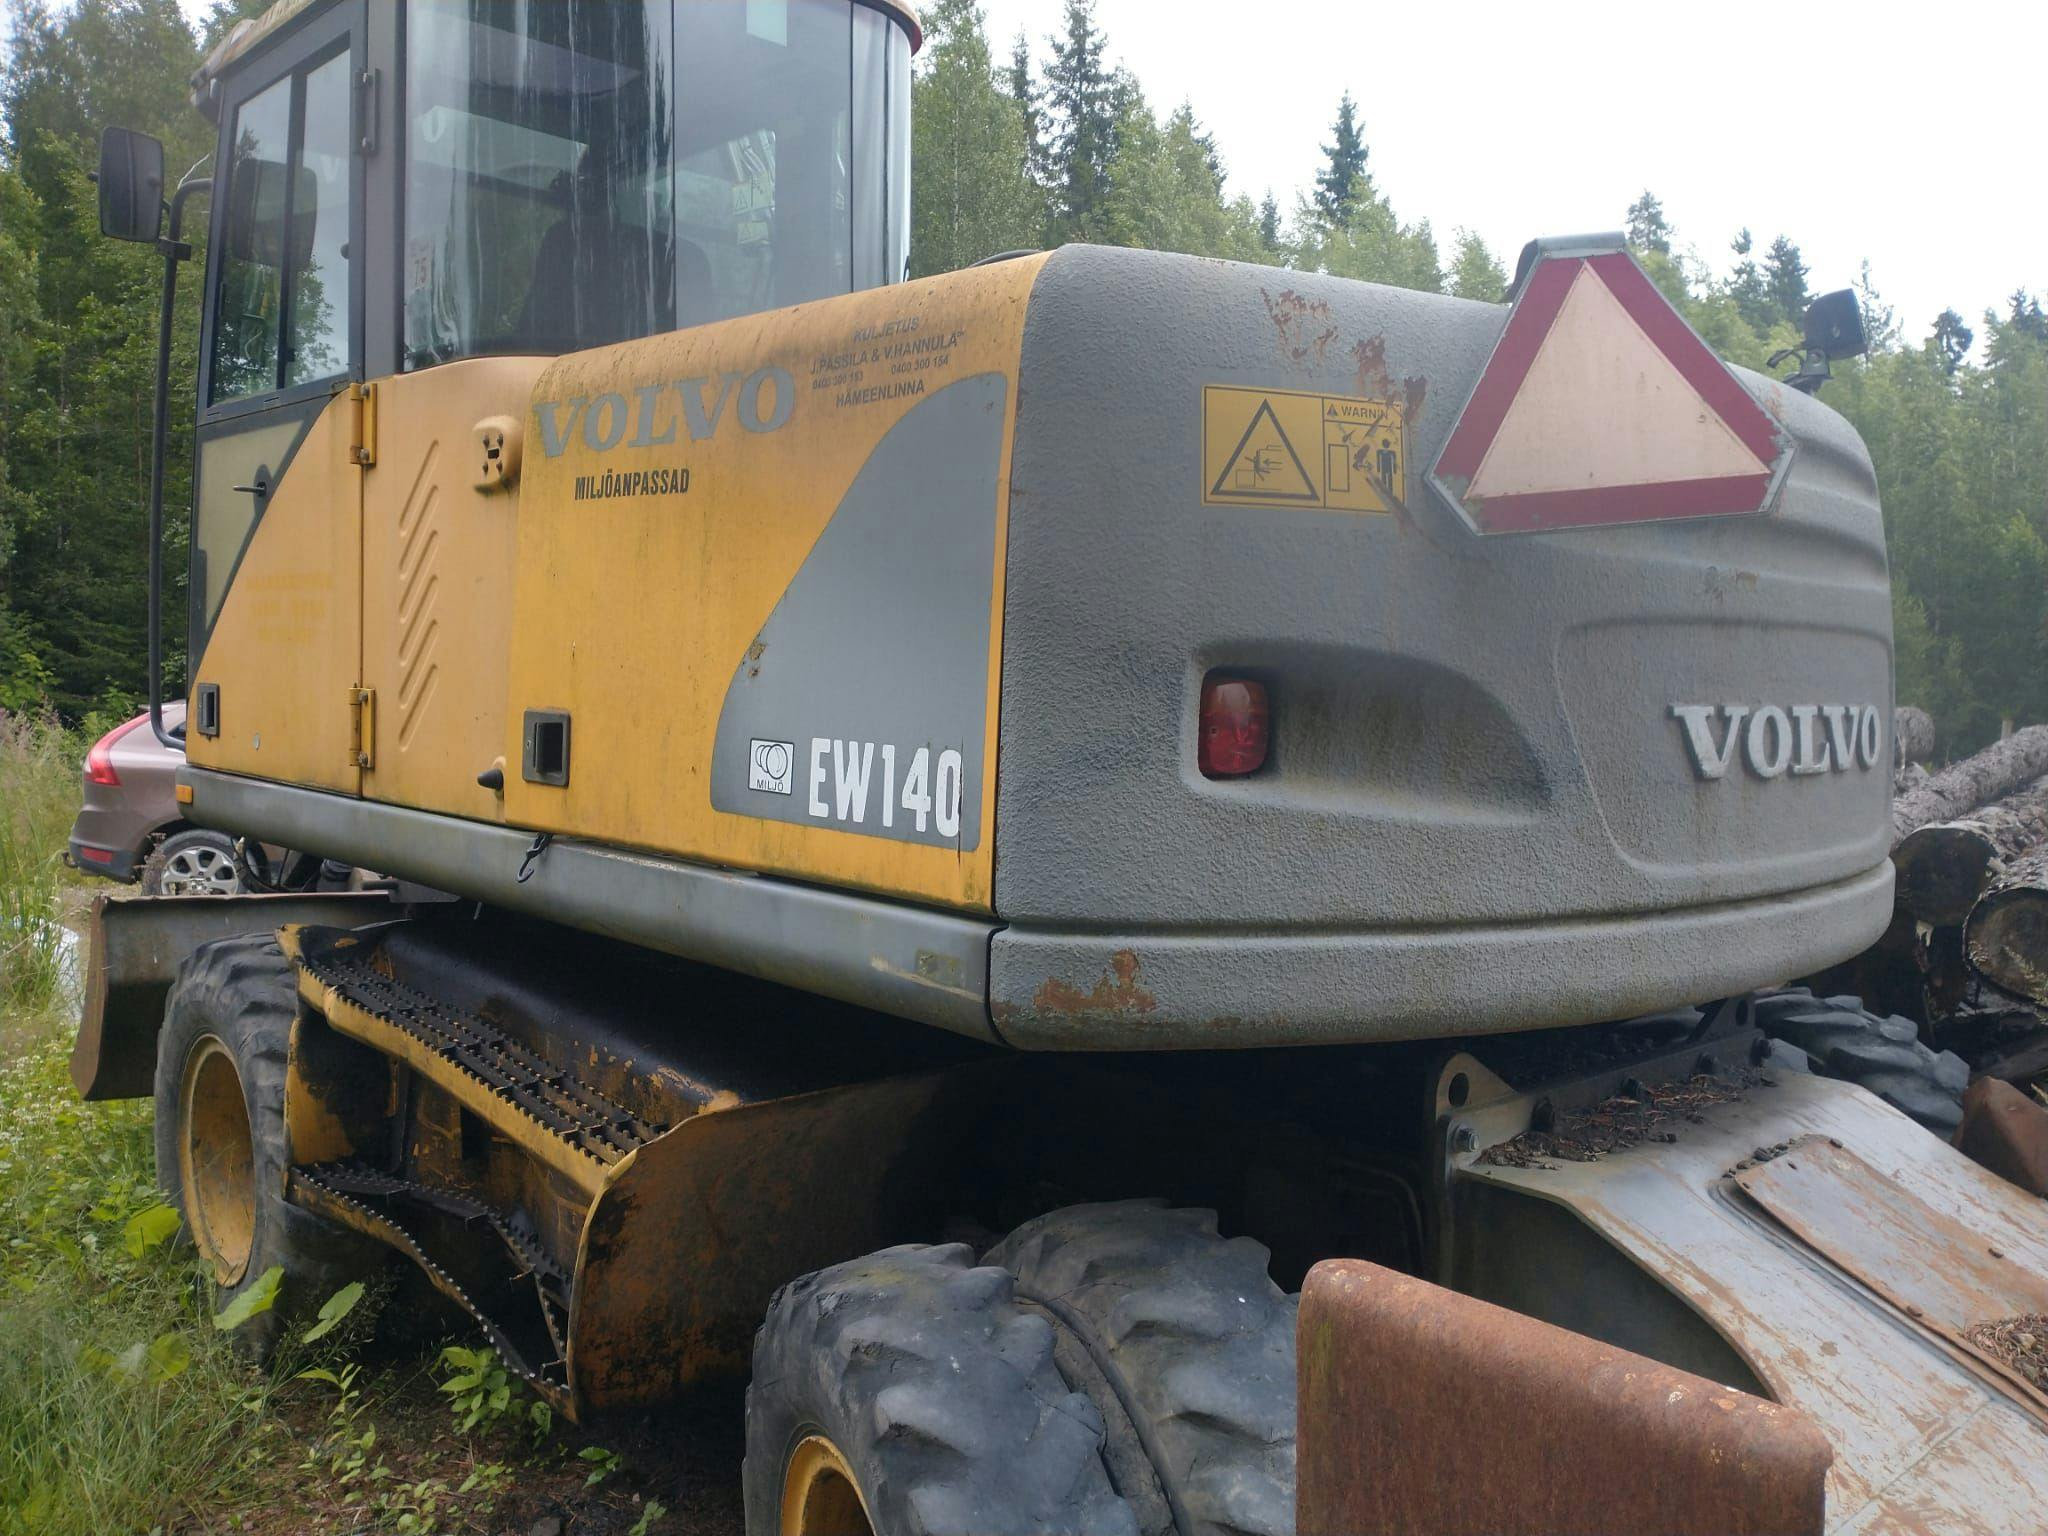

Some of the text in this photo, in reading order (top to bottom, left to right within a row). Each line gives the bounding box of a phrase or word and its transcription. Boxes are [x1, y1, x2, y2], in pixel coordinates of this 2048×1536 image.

[855, 317, 920, 343] KULJETUS
[871, 349, 880, 364] &
[891, 363, 912, 376] 0400
[532, 366, 795, 458] VOLVO
[1341, 406, 1389, 422] WARNIN
[574, 468, 691, 501] MILJÖANPASSAD
[1670, 704, 1882, 779] VOLVO
[756, 779, 784, 792] MILJÖ
[809, 737, 962, 837] EW140
